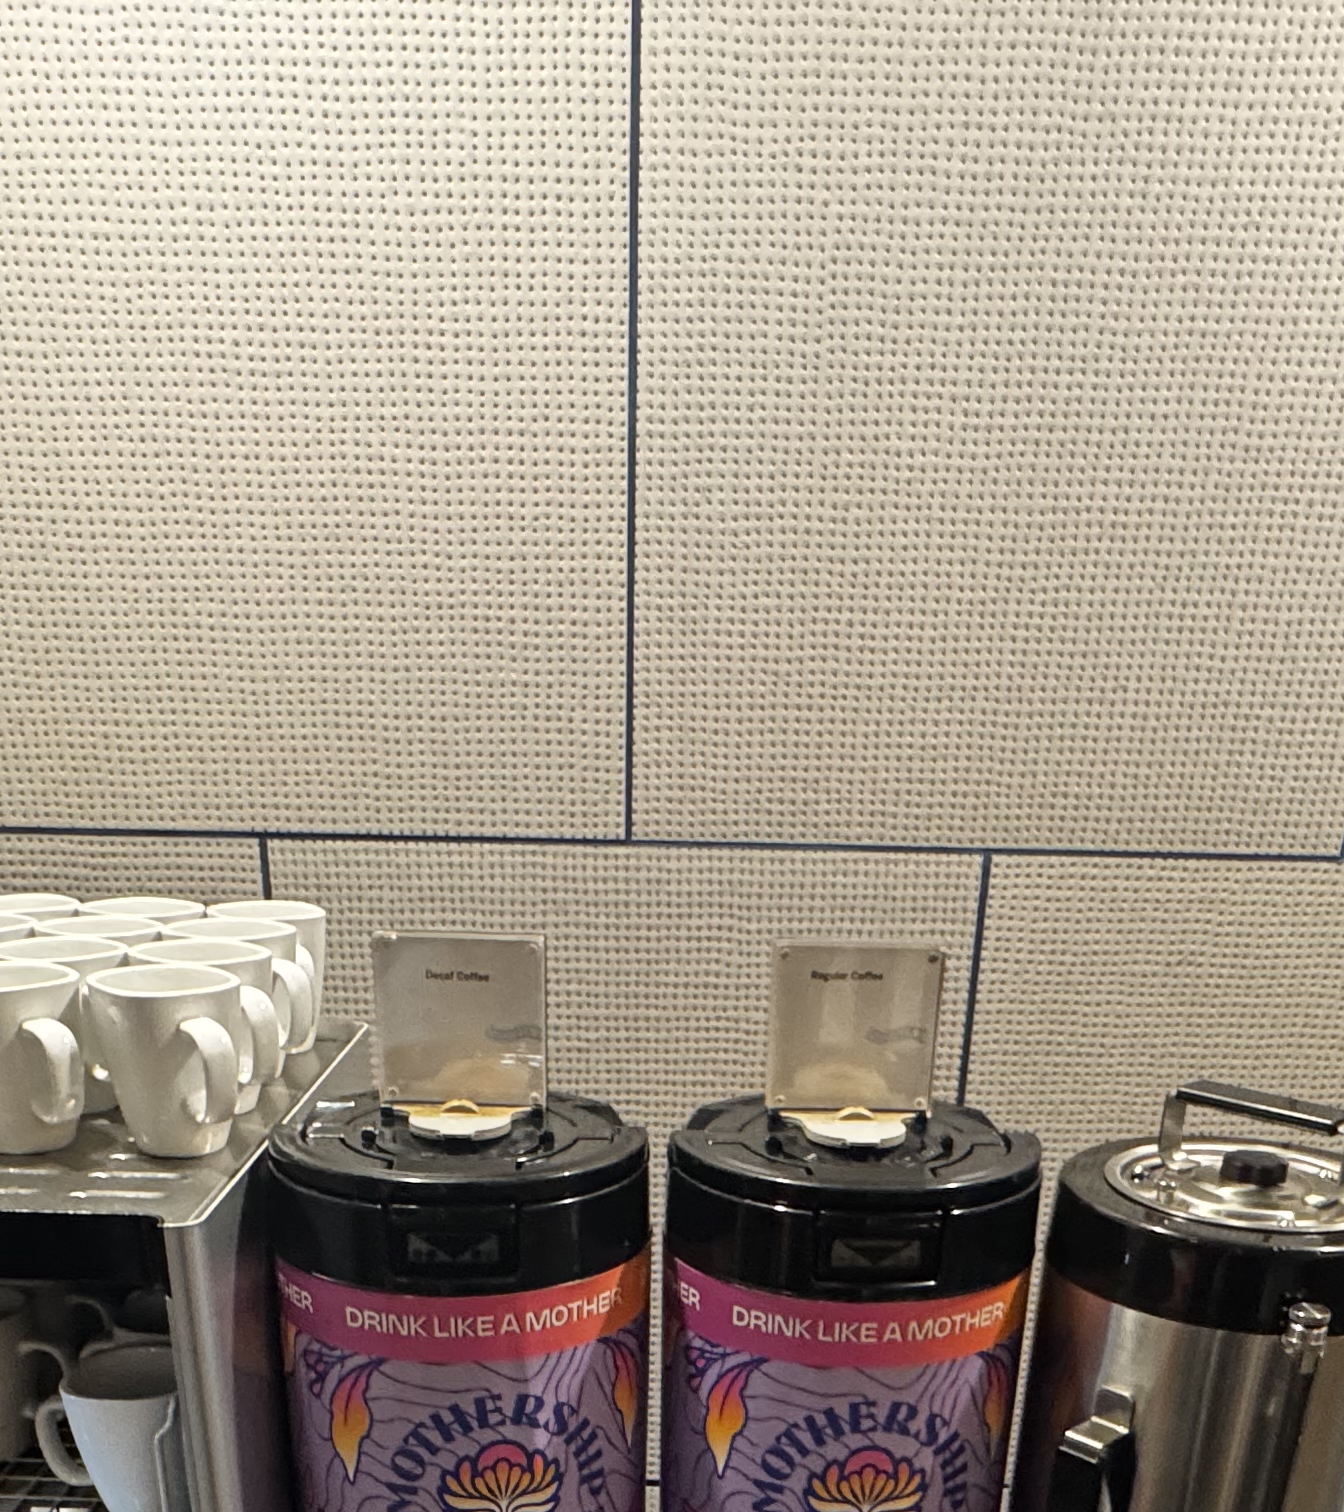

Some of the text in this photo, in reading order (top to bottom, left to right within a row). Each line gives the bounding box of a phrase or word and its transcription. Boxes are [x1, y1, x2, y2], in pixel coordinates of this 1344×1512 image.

[425, 968, 490, 982] Decaf Coffee
[810, 969, 884, 982] Regular Coffee
[345, 1287, 623, 1339] DRINK LIKE A MOTHER
[732, 1300, 1005, 1343] DRINK LIKE A MOTHER
